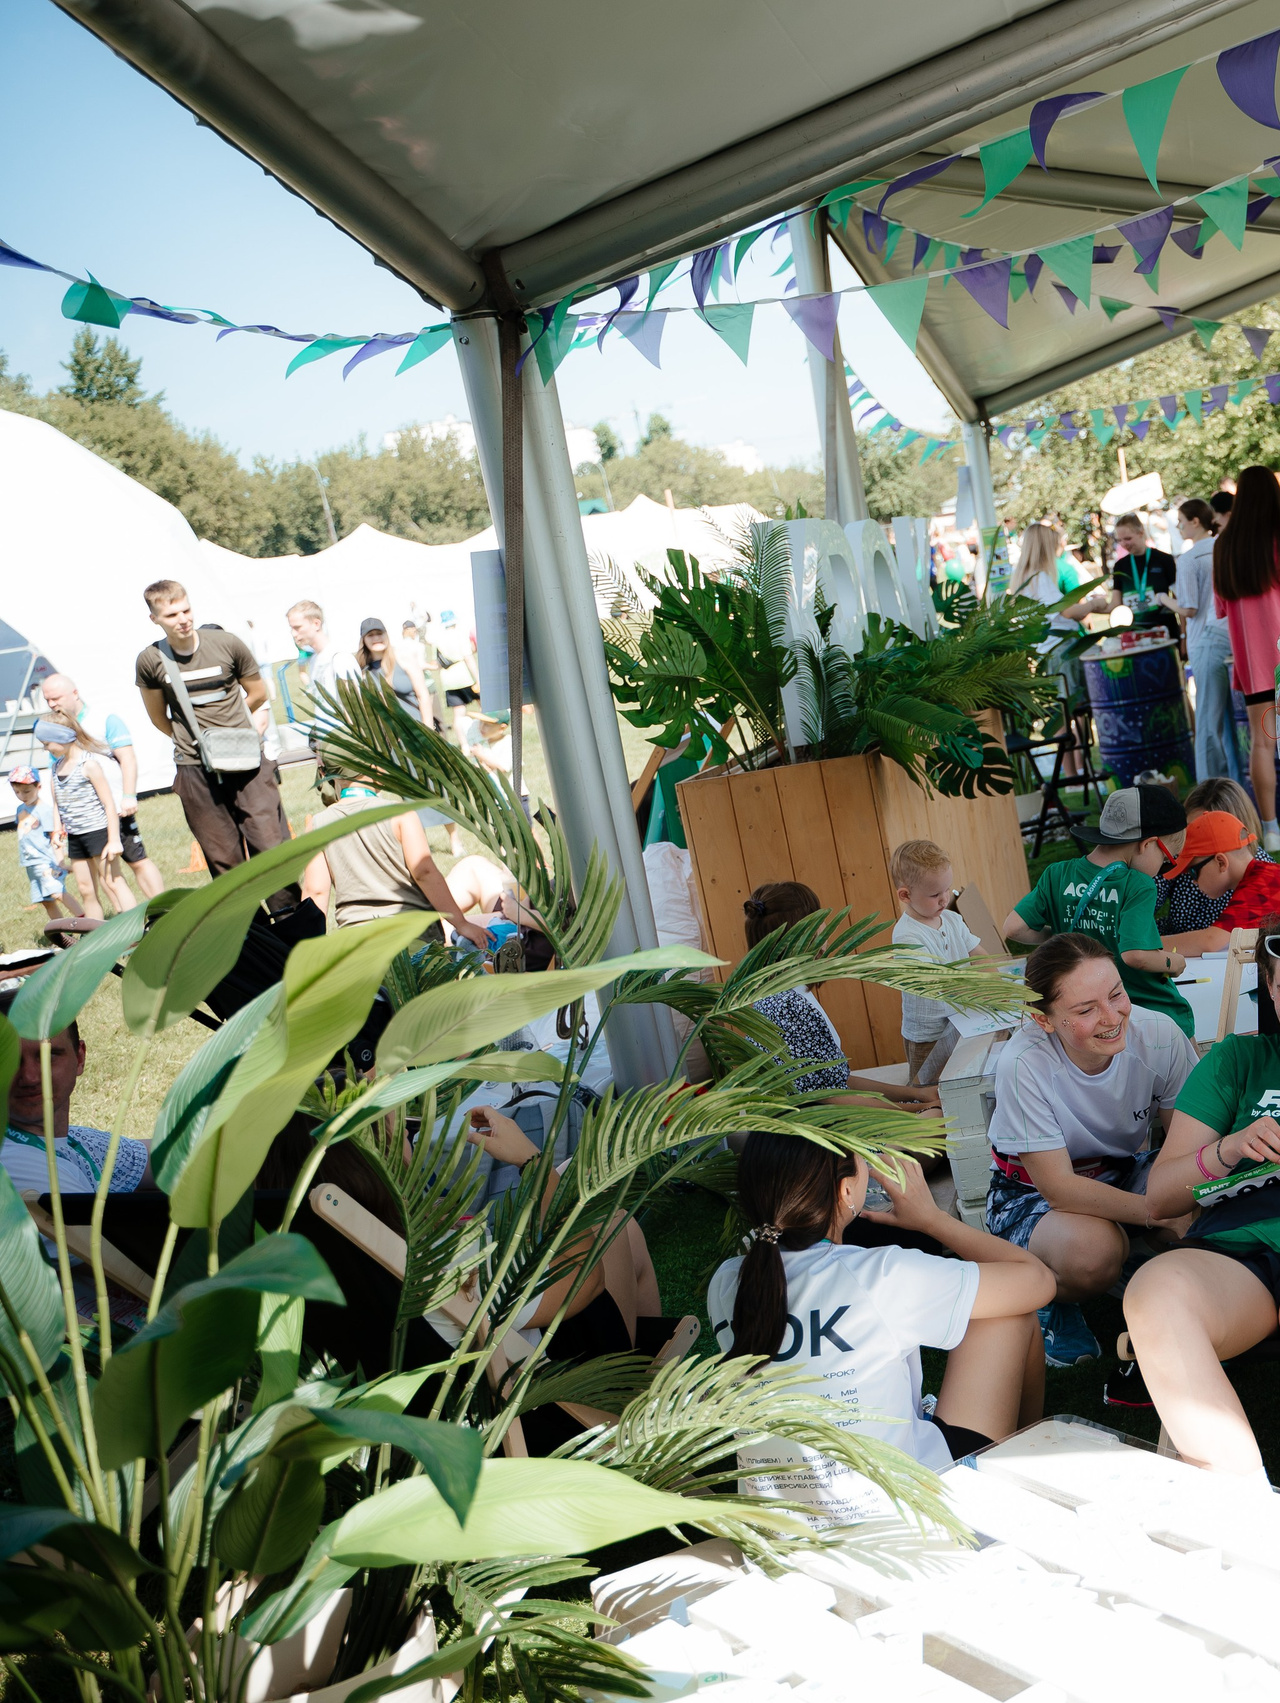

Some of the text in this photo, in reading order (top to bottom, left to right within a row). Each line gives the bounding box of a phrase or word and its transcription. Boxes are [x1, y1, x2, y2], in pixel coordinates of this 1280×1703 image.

[1063, 882, 1119, 904] AGMA
[1087, 876, 1102, 897] AGIMA
[1251, 1109, 1261, 1118] by
[7, 1128, 29, 1143] RUN
[1199, 1182, 1231, 1196] RUNIT
[822, 1368, 856, 1380] КРОК?
[840, 1388, 858, 1397] МЫ
[793, 1470, 832, 1481] ГЛАВНОЙ
